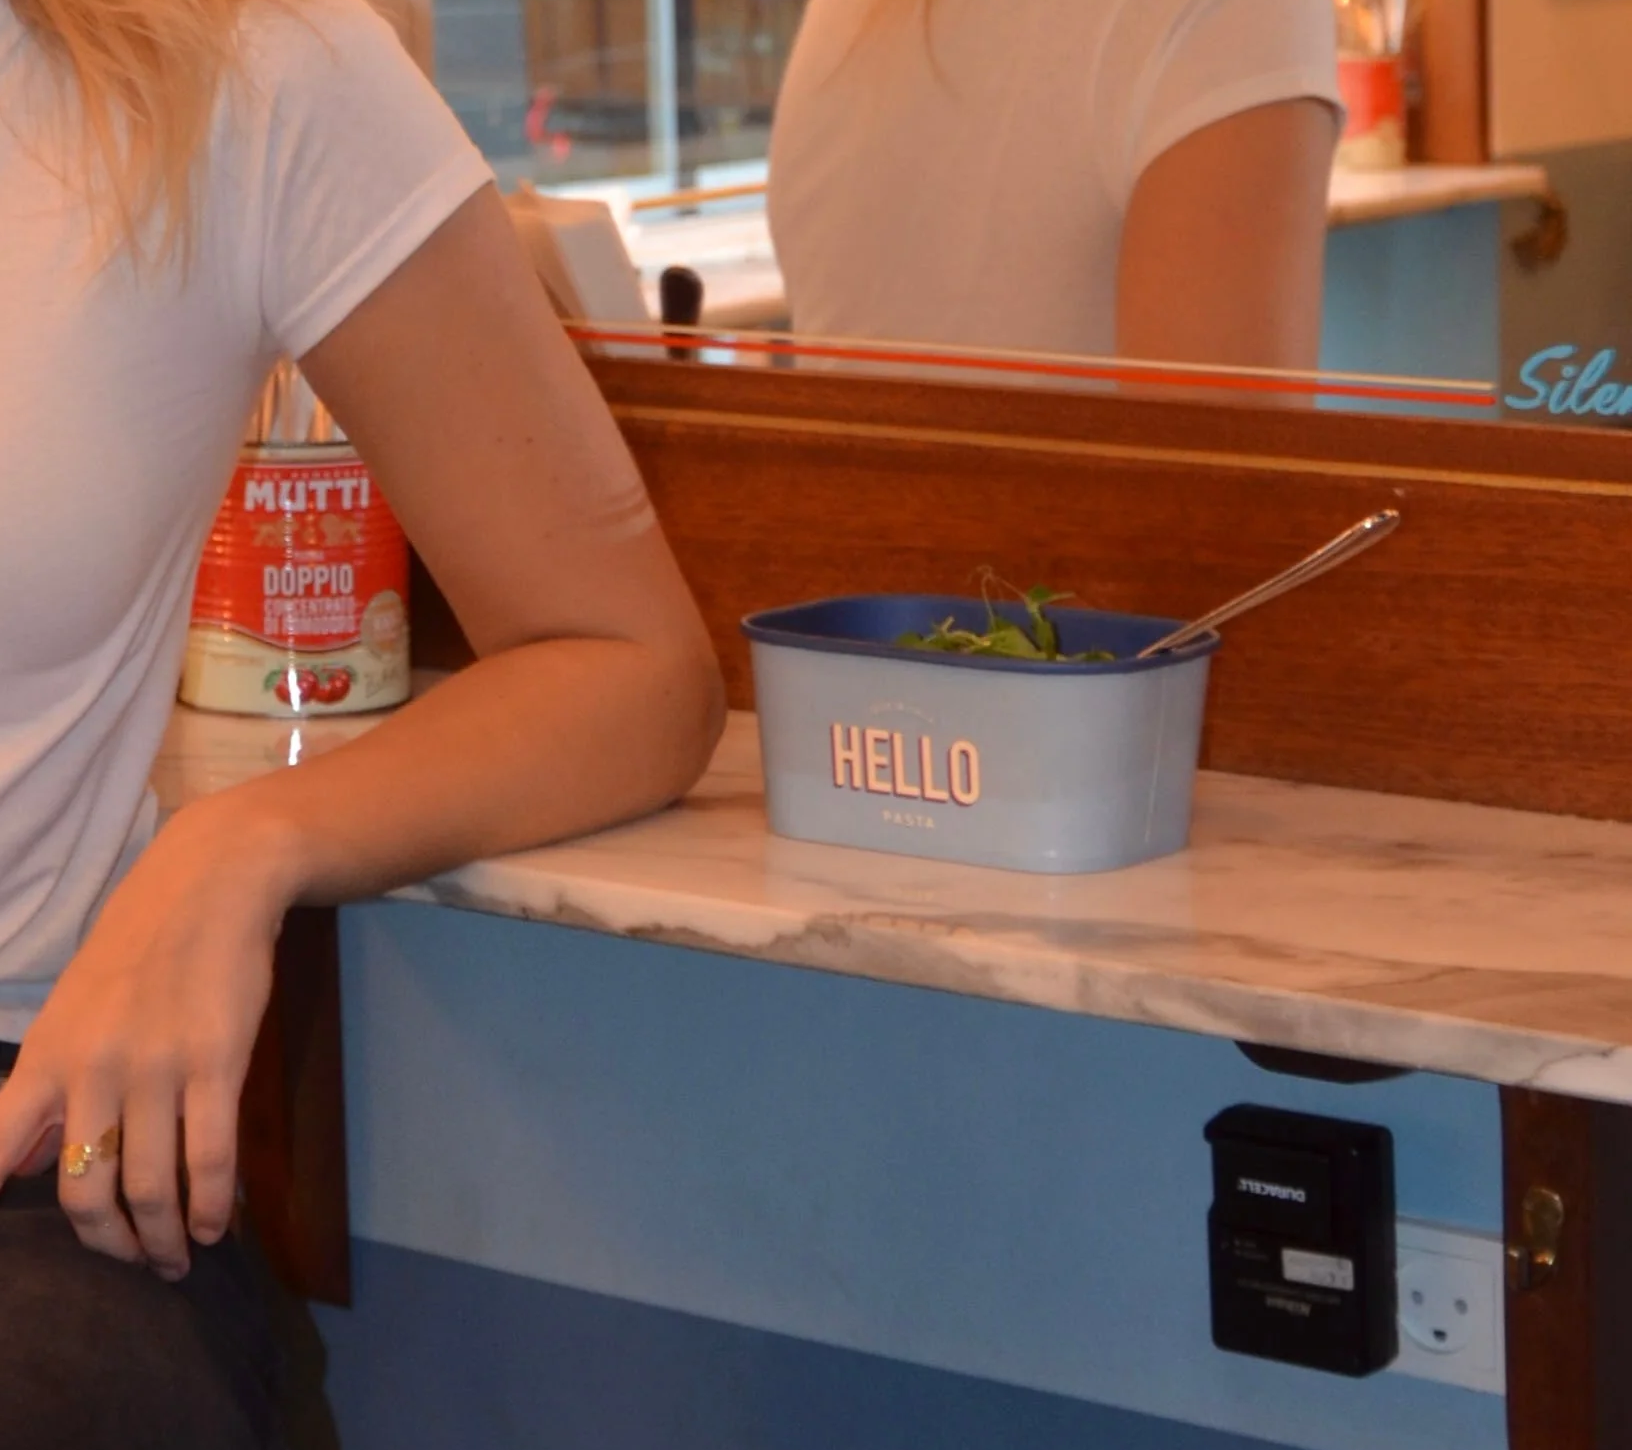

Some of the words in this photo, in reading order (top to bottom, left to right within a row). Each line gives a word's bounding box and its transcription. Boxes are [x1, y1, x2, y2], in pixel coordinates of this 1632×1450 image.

[244, 477, 370, 512] MUTTI
[263, 565, 355, 597] DOPPIO
[830, 722, 981, 807] HELLO
[881, 809, 936, 830] PASTA
[1236, 1176, 1306, 1203] DURACELL
